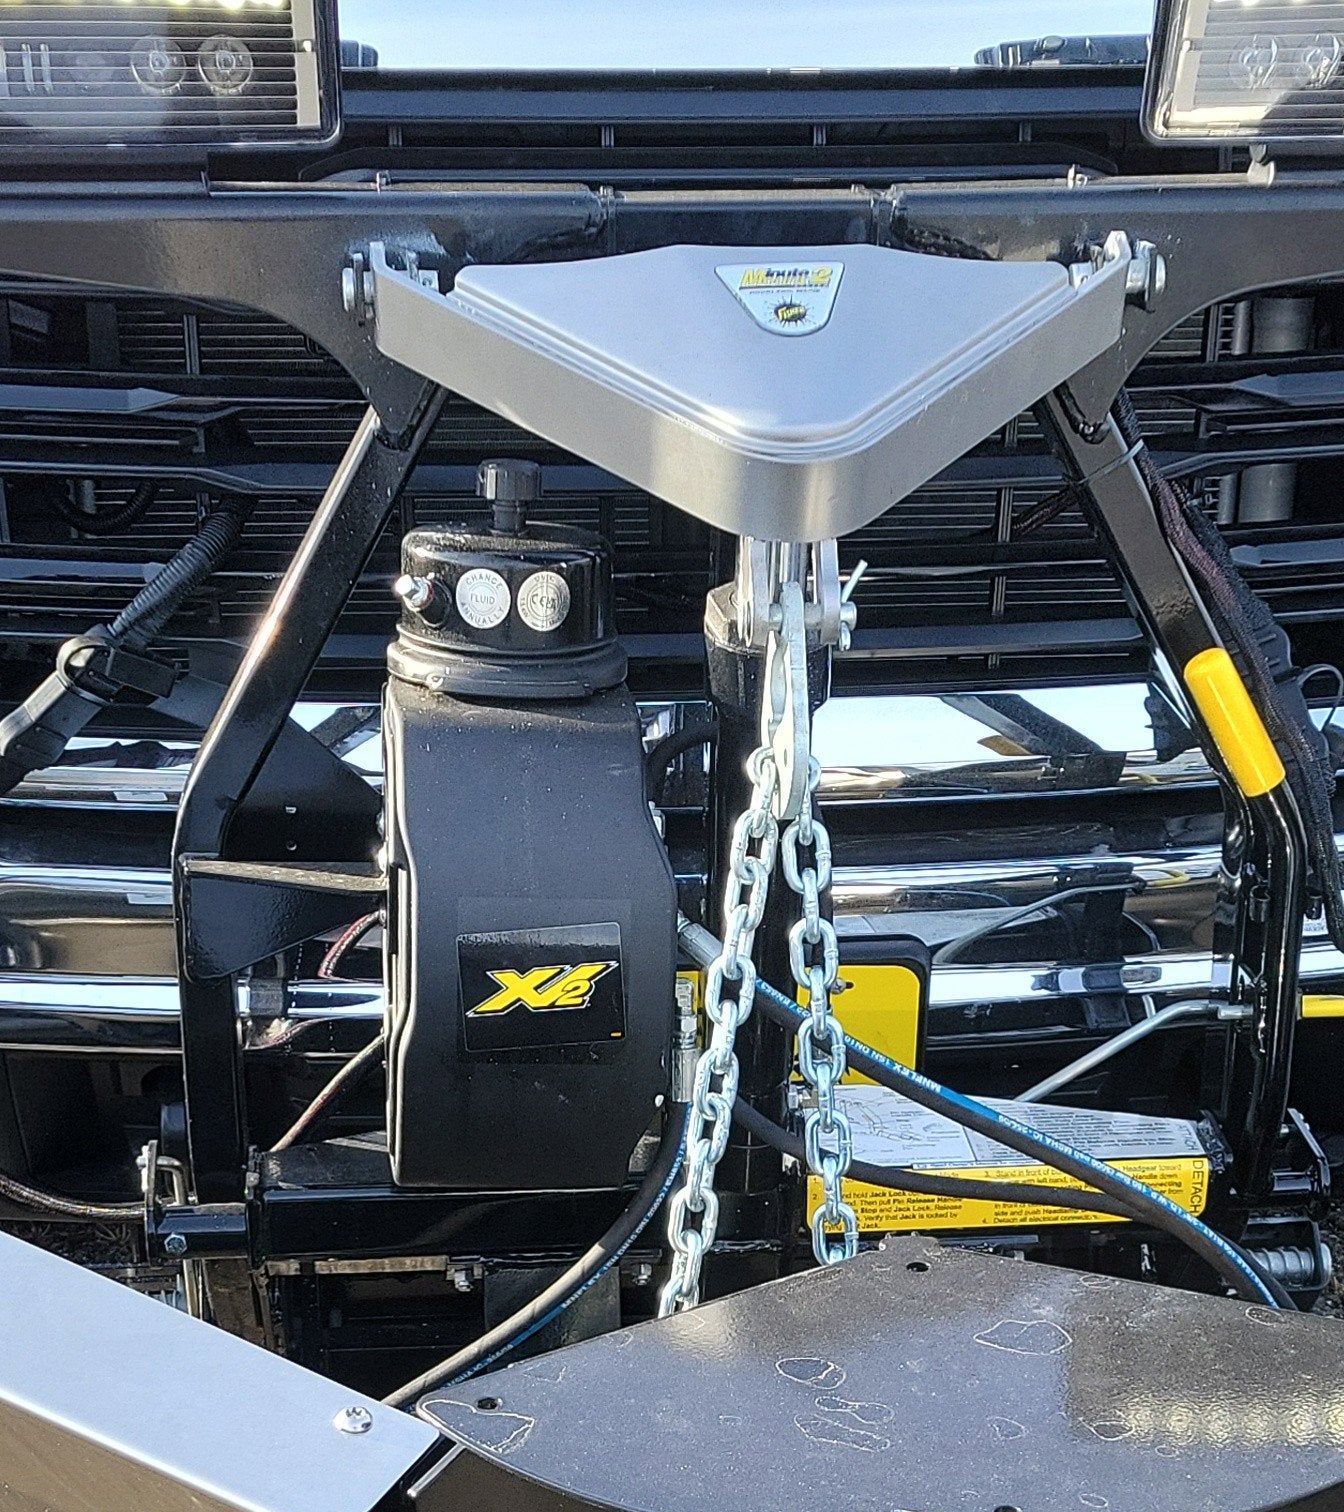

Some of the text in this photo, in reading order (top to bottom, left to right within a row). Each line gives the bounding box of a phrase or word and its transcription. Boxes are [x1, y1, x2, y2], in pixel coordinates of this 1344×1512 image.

[466, 573, 503, 589] CHANGE
[471, 593, 496, 605] FLUID
[460, 602, 505, 626] ANNUALLY
[1190, 1160, 1204, 1213] DETACH
